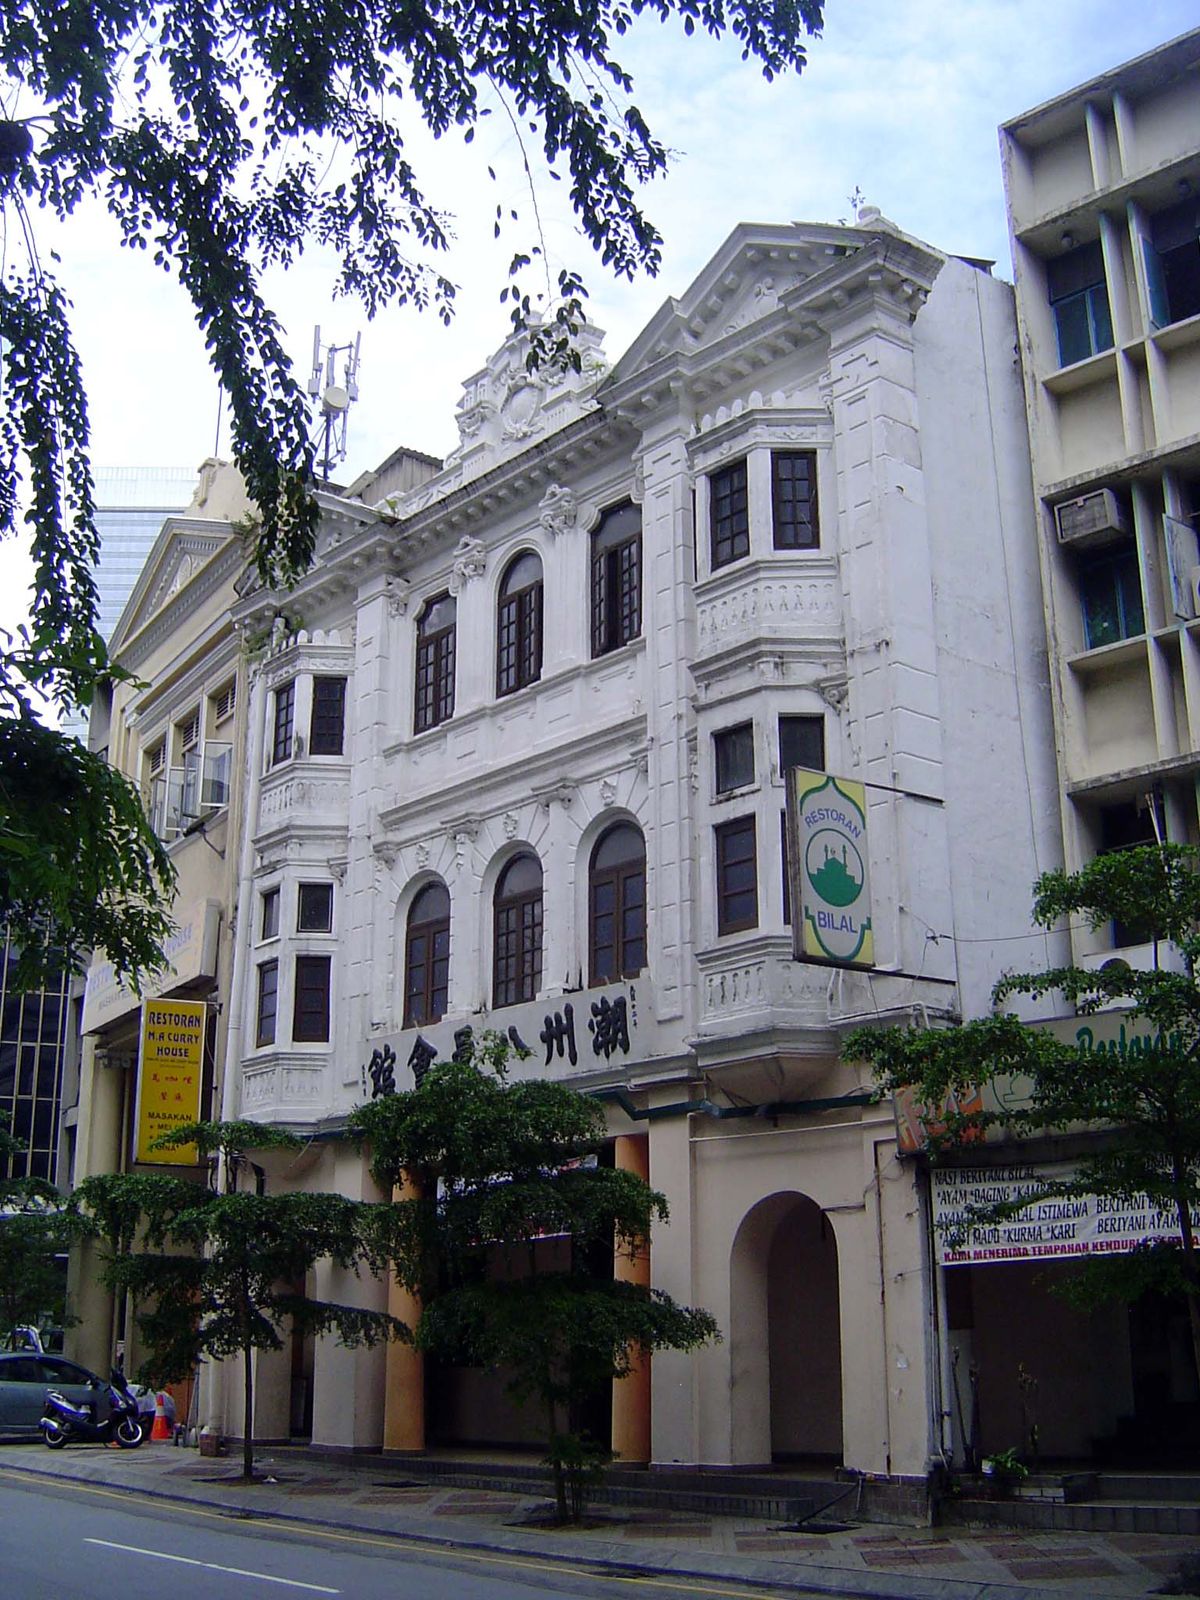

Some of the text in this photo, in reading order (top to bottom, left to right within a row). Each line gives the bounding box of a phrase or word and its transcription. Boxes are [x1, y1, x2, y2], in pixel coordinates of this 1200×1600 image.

[805, 808, 861, 839] RESTORAN
[817, 911, 858, 934] BILAL
[149, 1011, 201, 1028] RESTORAN
[168, 1032, 200, 1045] CURRY
[157, 1046, 190, 1058] HOUSE
[148, 1111, 192, 1122] MASAKAN
[935, 1170, 957, 1186] NASI
[1037, 1201, 1089, 1220] ISTIMEWA
[1098, 1214, 1146, 1233] BERIYANI
[1149, 1211, 1180, 1229] AYAM
[944, 1249, 971, 1263] KAMI
[974, 1246, 1029, 1260] MENERIMA
[1031, 1241, 1089, 1257] TEMPAHAN
